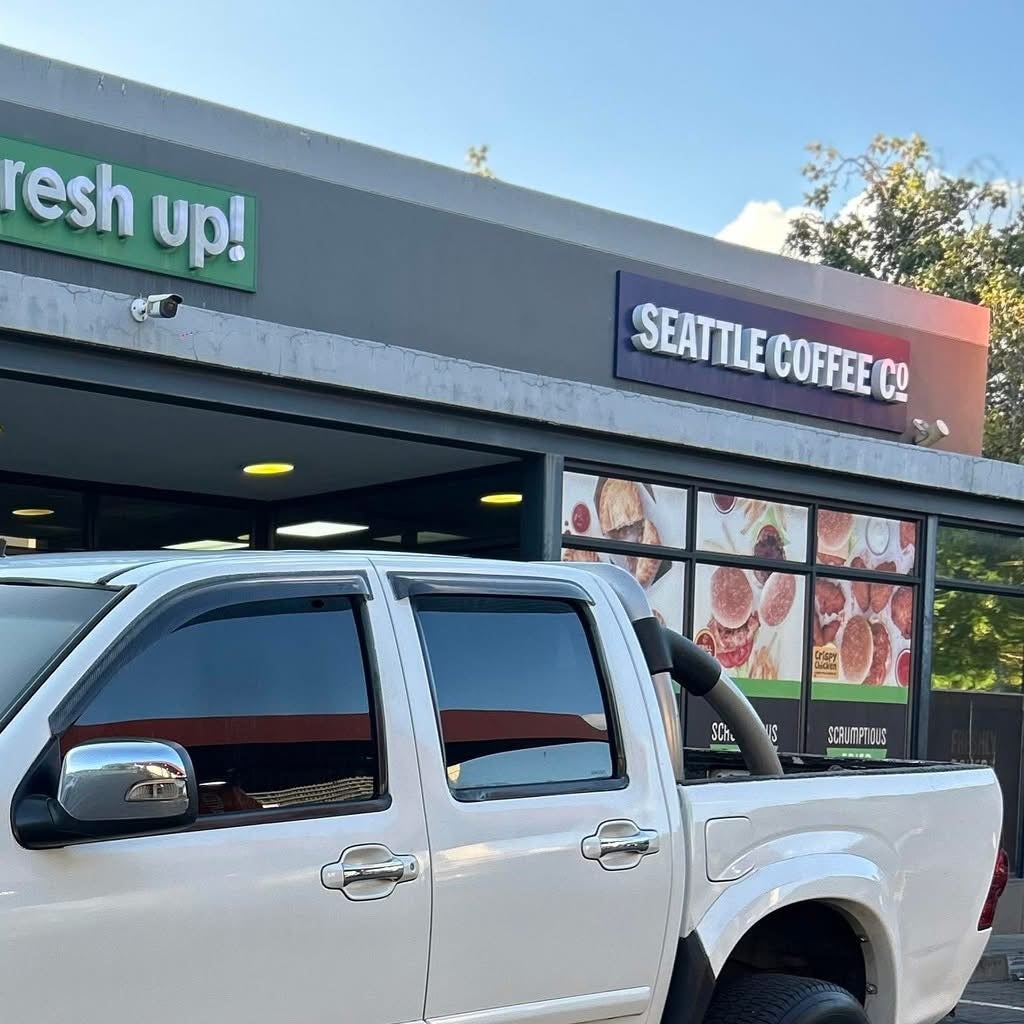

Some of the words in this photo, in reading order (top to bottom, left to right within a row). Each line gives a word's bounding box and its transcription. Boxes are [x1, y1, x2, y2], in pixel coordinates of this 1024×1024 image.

[151, 193, 246, 269] up!
[631, 302, 768, 374] SEATTLE
[766, 333, 873, 396] COFFEE
[814, 650, 837, 662] Crispy
[827, 725, 887, 746] SCRUMPTIOUS
